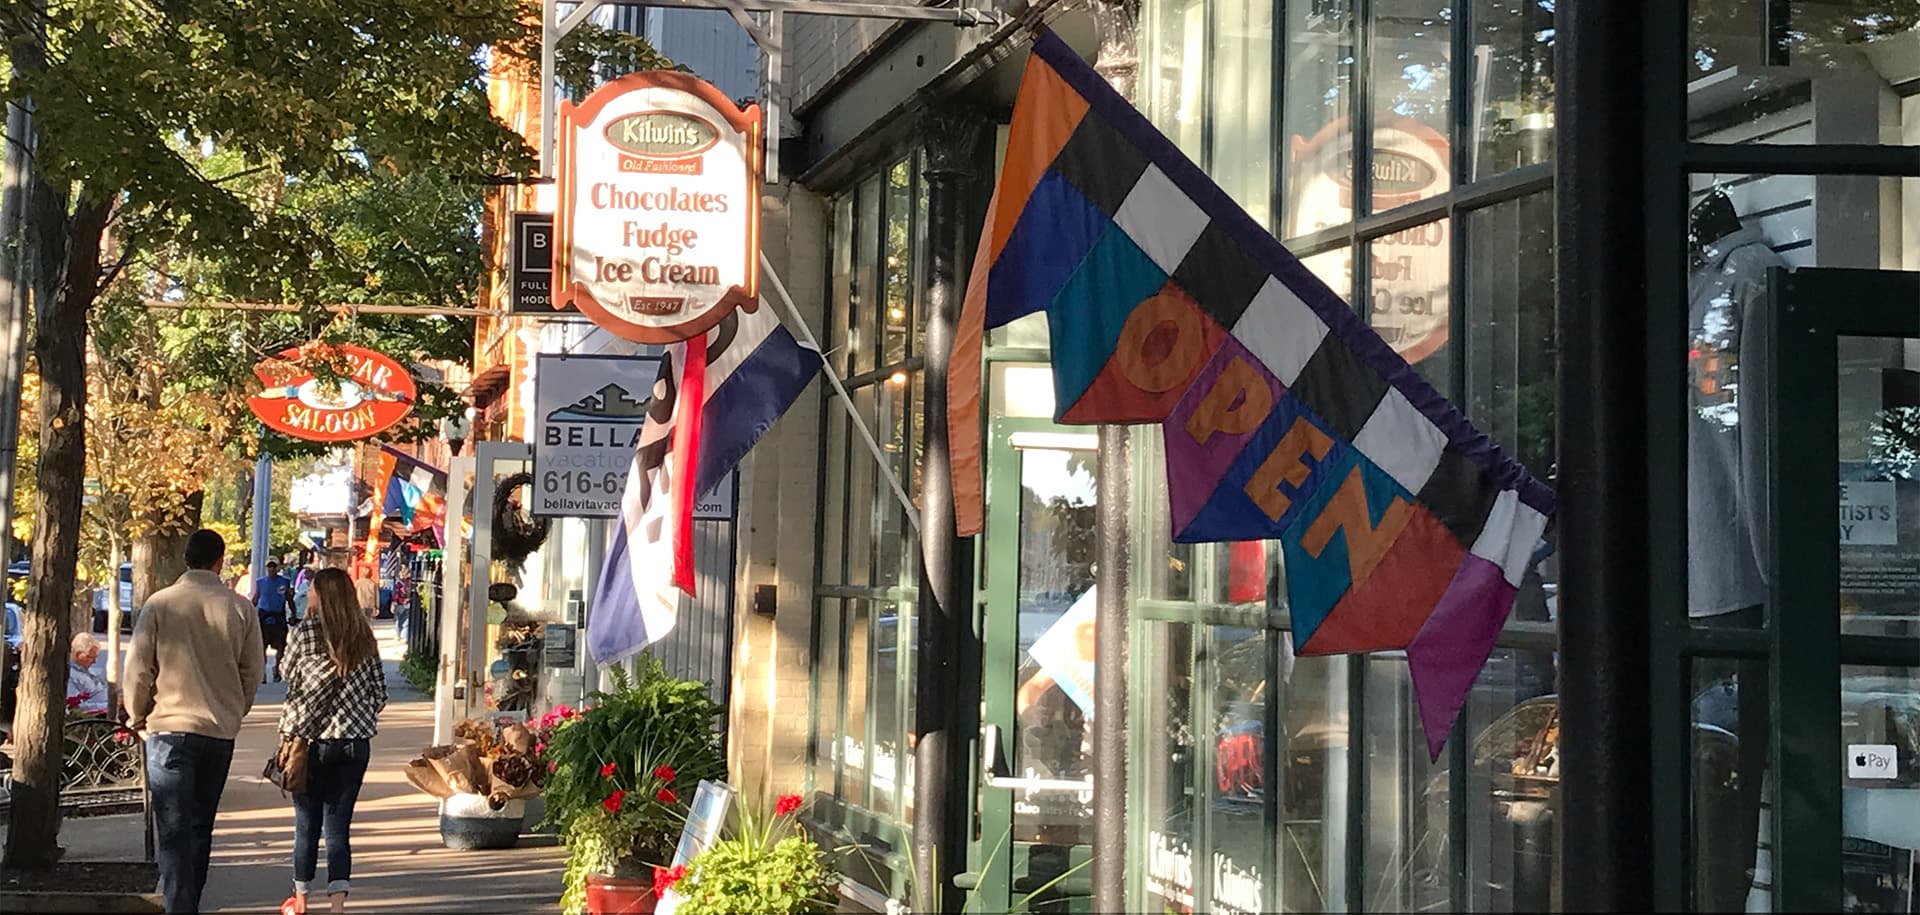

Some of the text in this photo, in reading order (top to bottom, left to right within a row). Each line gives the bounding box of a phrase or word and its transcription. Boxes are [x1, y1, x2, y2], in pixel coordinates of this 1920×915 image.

[623, 118, 699, 146] Kilwin's
[623, 159, 698, 174] Old Fashioned
[591, 182, 729, 213] Chocolates
[532, 233, 547, 248] B
[622, 220, 698, 256] Fudge
[595, 255, 721, 285] Ice Cream
[521, 281, 548, 290] FULL
[281, 403, 376, 433] SALOON
[1116, 294, 1416, 594] OPEN
[544, 450, 634, 469] vacatio
[1867, 752, 1891, 771] Pay
